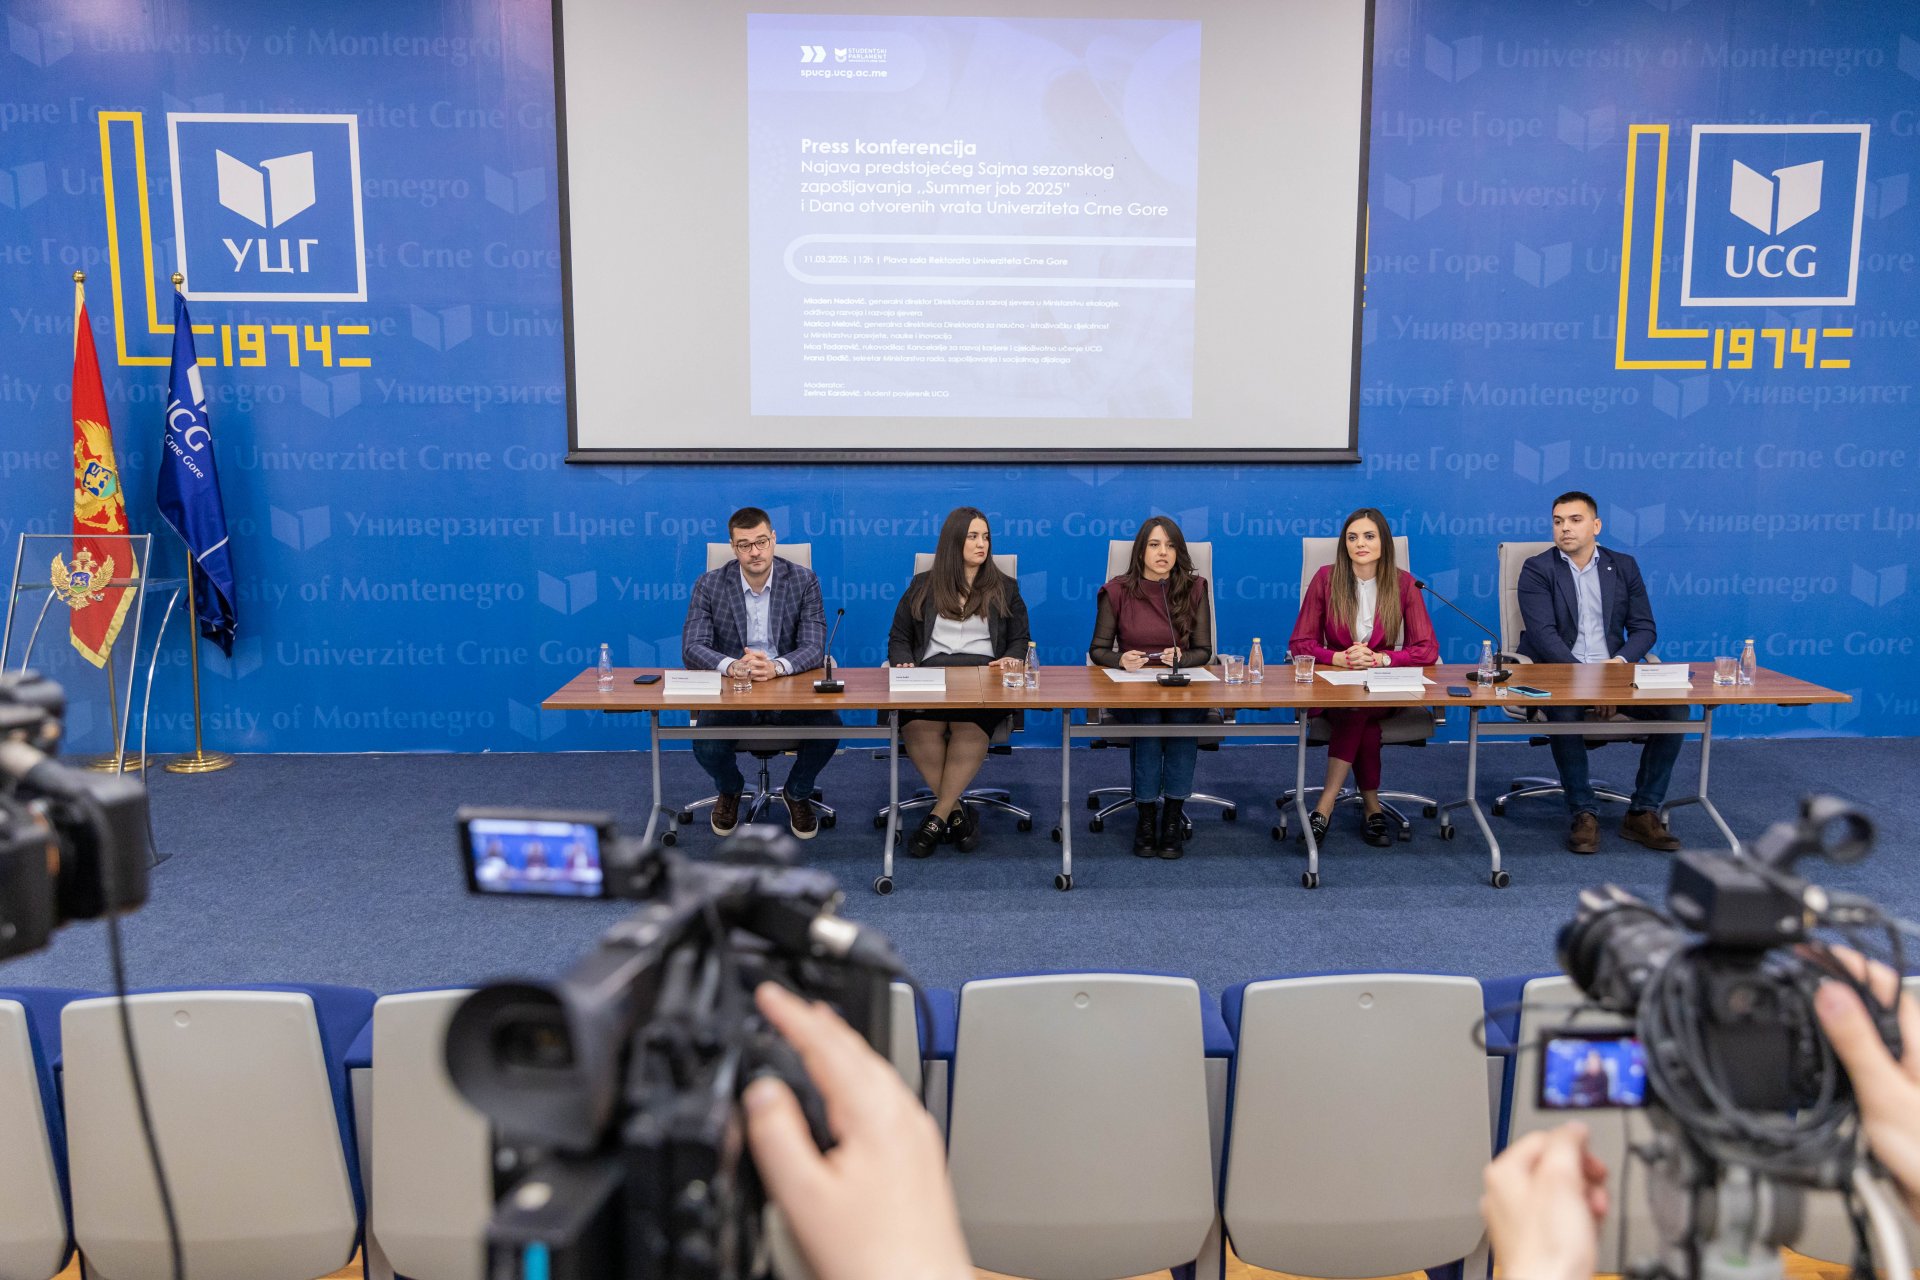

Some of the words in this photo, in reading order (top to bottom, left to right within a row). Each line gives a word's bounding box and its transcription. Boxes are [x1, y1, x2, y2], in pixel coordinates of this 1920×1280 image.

[89, 27, 253, 63] University
[264, 26, 297, 56] of
[306, 29, 499, 66] Montenegro
[1497, 38, 1649, 77] University
[1661, 38, 1692, 69] of
[1701, 41, 1884, 77] Montenegro
[800, 69, 888, 79] spucg.ucg.ac.me
[0, 103, 61, 131] рне
[429, 101, 505, 129] Crne
[1381, 110, 1463, 146] Црне
[1472, 109, 1543, 147] Горе
[800, 138, 850, 155] Press
[855, 138, 977, 157] konferencija
[800, 160, 860, 177] Najava
[865, 161, 974, 178] predstojećeg
[978, 162, 1028, 179] Sajma
[1032, 163, 1114, 180] sezonskog
[363, 178, 470, 208] enegro
[800, 180, 912, 197] zapošljavanja
[995, 182, 1021, 198] job
[1456, 177, 1607, 215] University
[809, 200, 855, 214] Dana
[860, 200, 935, 215] otvorenih
[940, 202, 982, 215] vrata
[987, 201, 1079, 216] Univerziteta
[1083, 202, 1123, 217] Crne
[1127, 203, 1168, 217] Gore
[222, 238, 319, 274] УЦГ
[398, 241, 473, 268] Crne
[484, 241, 559, 268] Gore
[883, 255, 907, 265] Plava
[910, 256, 926, 265] sala
[929, 256, 970, 265] Rektorata
[972, 256, 1021, 266] Univerziteta
[1023, 256, 1044, 266] Crne
[1046, 257, 1068, 267] Gore
[1368, 253, 1420, 282] рне
[1428, 247, 1500, 282] Горе
[1725, 244, 1817, 279] UCG
[1860, 251, 1915, 273] ore
[221, 325, 333, 368] 1974
[1391, 314, 1584, 349] Универзитет
[1712, 328, 1817, 369] 1974
[376, 378, 564, 413] Универзите
[1423, 379, 1454, 407] of
[1462, 381, 1640, 414] Montenegro
[1723, 379, 1912, 412] Универзитет
[0, 449, 60, 479] рне
[182, 455, 204, 479] Gore
[234, 441, 408, 471] Univerzitet
[418, 443, 492, 471] Crne
[503, 444, 563, 471] Gor
[1429, 446, 1501, 480] Горе
[1583, 443, 1745, 470] Univerzitet
[1754, 443, 1823, 470] Crne
[1834, 442, 1906, 469] Gore
[345, 511, 540, 548] Универзитет
[553, 511, 635, 545] Црне
[645, 511, 717, 545] Горе
[803, 510, 942, 537] Univerzit
[1063, 511, 1136, 538] Gore
[1418, 511, 1551, 537] Montene
[1678, 508, 1866, 540] Универзитет
[300, 574, 332, 603] of
[339, 576, 526, 610] Montenegro
[1665, 571, 1838, 602] Montenegro
[276, 639, 451, 669] Univerzitet
[459, 642, 530, 669] Crne
[1766, 631, 1833, 656] Crne
[1843, 631, 1913, 655] Gore
[273, 702, 303, 730] of
[313, 704, 495, 736] Montenegro
